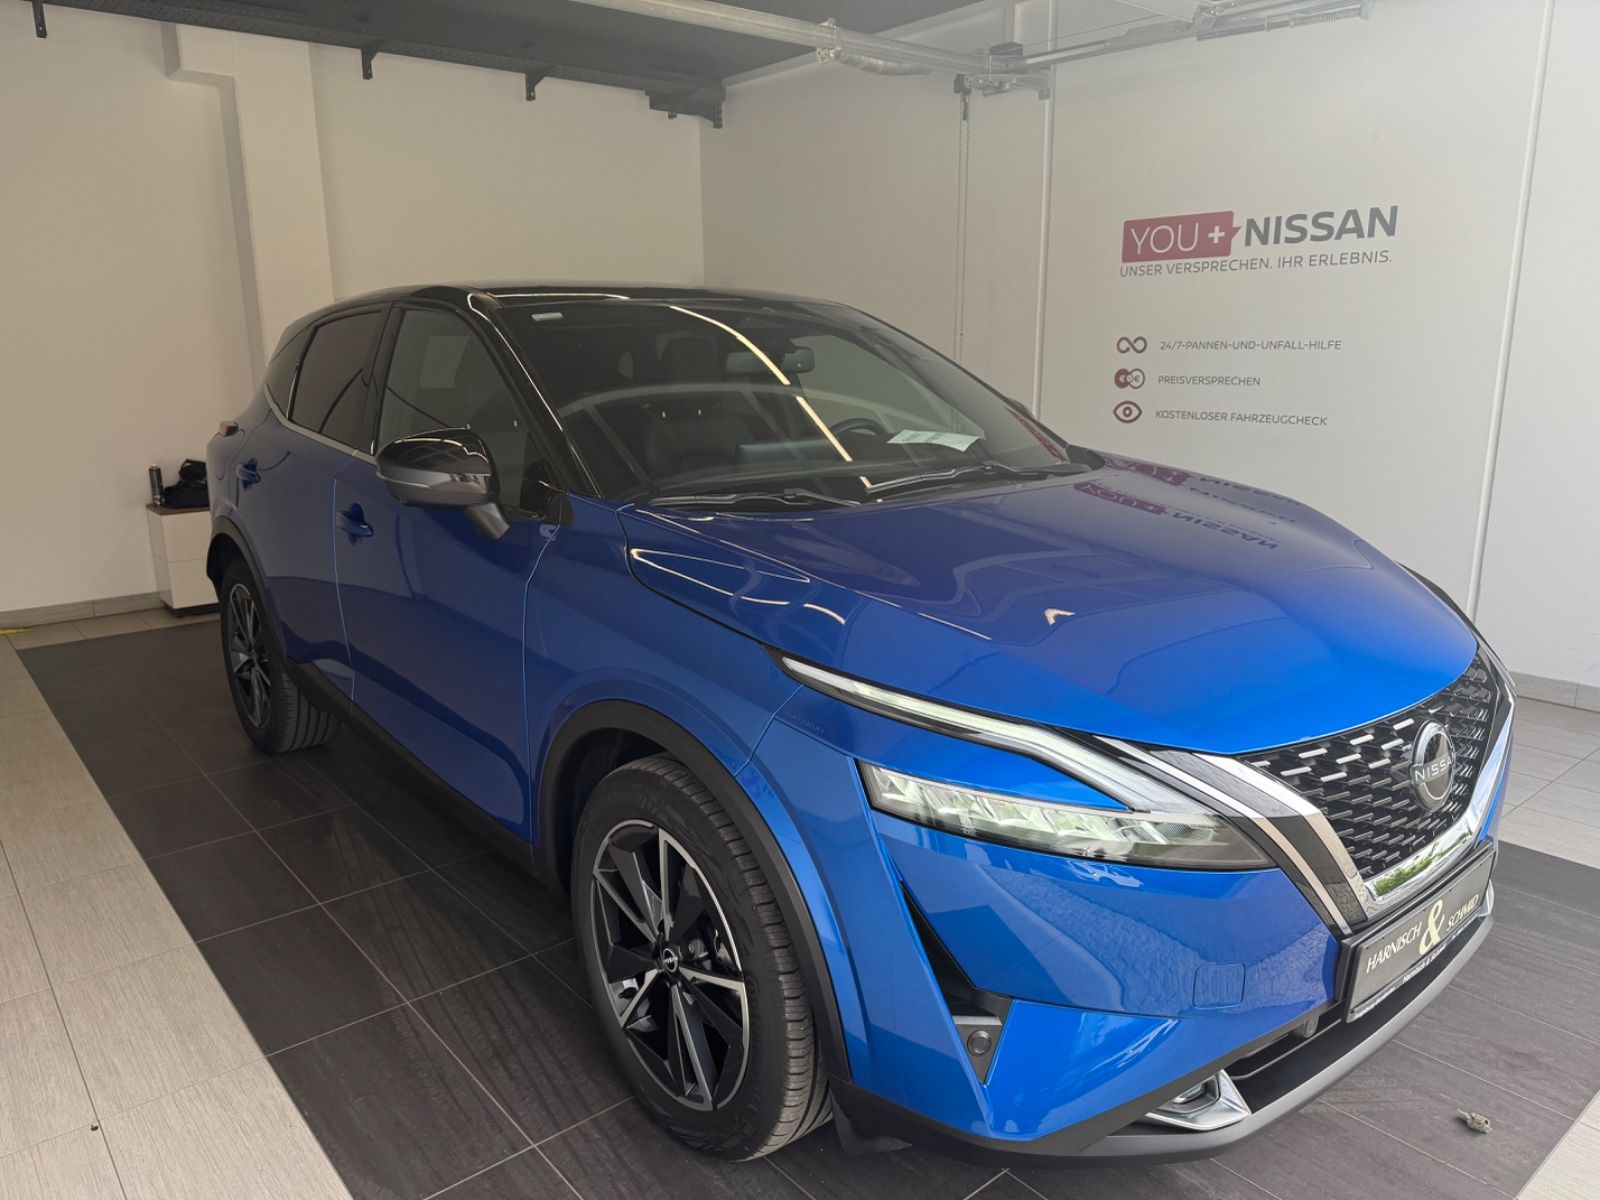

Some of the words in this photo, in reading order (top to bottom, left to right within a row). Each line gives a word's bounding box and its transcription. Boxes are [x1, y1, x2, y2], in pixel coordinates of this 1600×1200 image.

[1130, 222, 1200, 255] YOU
[1244, 204, 1399, 247] NISSAN
[1119, 263, 1163, 278] UNSER
[1165, 256, 1274, 276] VERSPRECHEN.
[1277, 255, 1304, 269] IHR
[1308, 249, 1393, 268] ERLEBNIS.
[1159, 339, 1343, 351] 24/7-PANNEN-UND-UNFALL-HILFE
[1157, 375, 1261, 386] PREISVERSPRECHEN
[1155, 409, 1228, 422] KOSTENLOSER
[1230, 412, 1328, 426] FAHRZEUGCHECK
[1414, 756, 1452, 782] NISSA
[1365, 921, 1423, 974] HARNISCH
[1419, 899, 1445, 955] &
